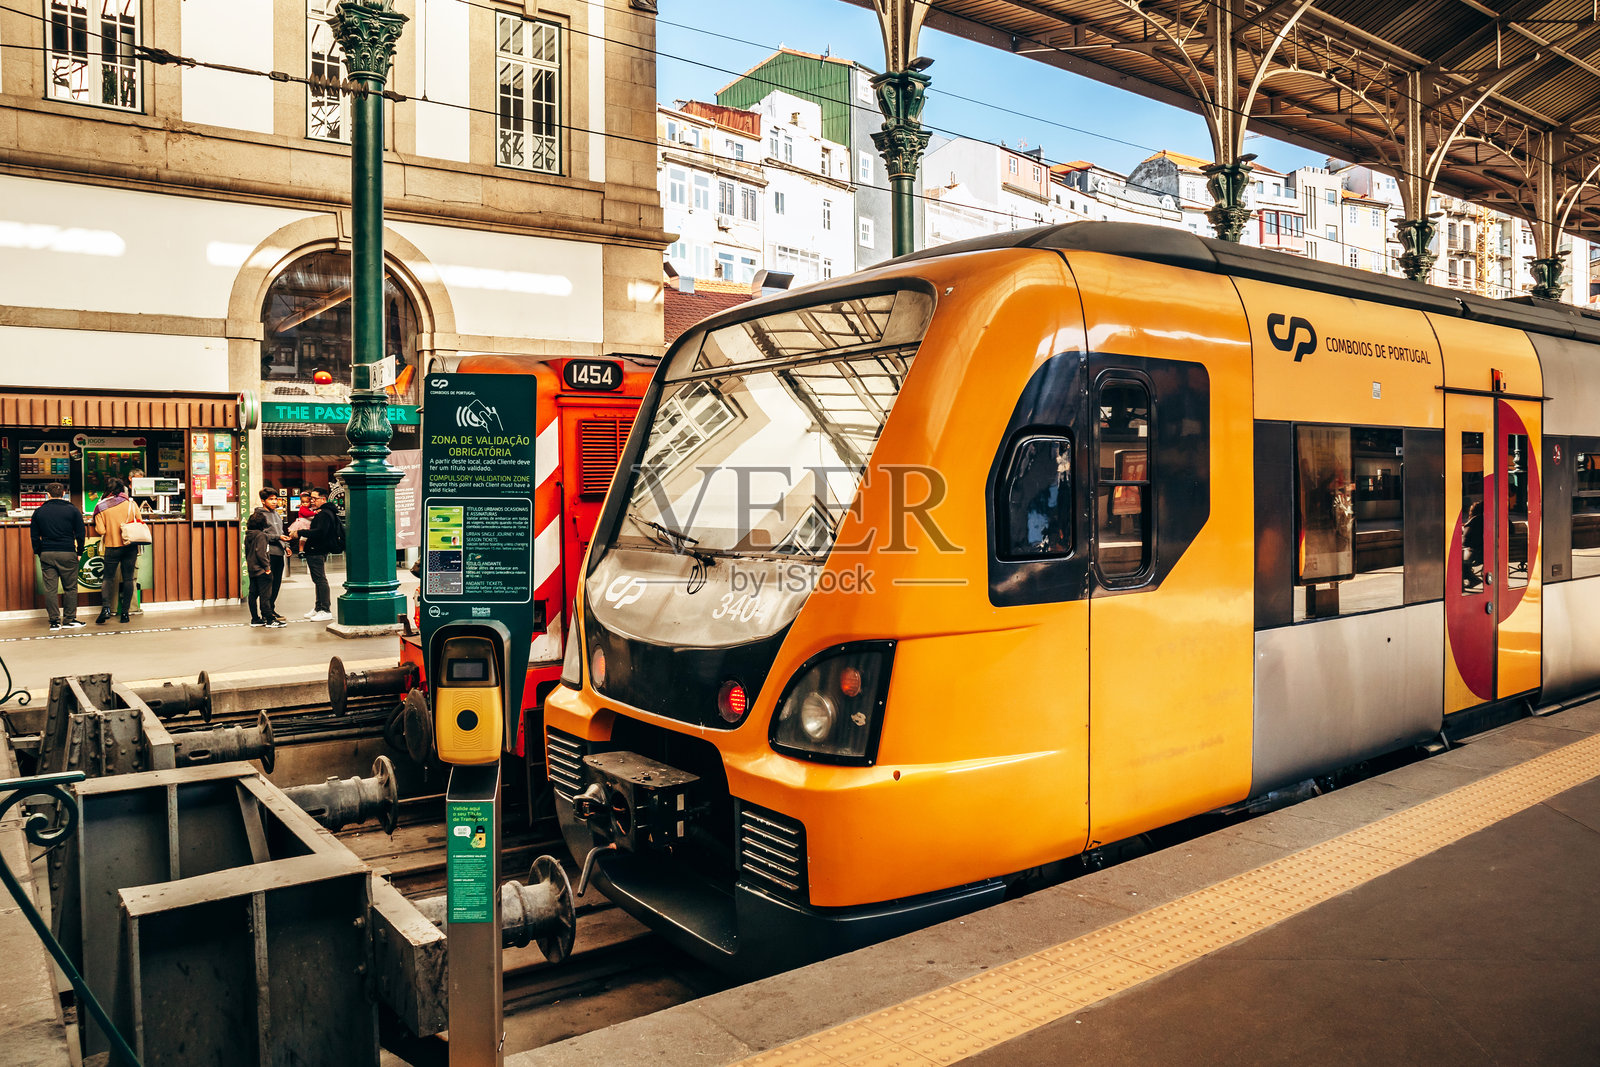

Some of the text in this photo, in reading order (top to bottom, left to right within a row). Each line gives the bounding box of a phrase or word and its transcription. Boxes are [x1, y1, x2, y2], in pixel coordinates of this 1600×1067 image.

[1326, 336, 1431, 364] COMBOIOS DE PORTUGAL
[573, 364, 612, 385] 1454
[276, 406, 309, 420] THE
[431, 435, 530, 447] ZONA DE VALIDAÇÃO
[448, 446, 511, 456] OBRIGATÓRIA
